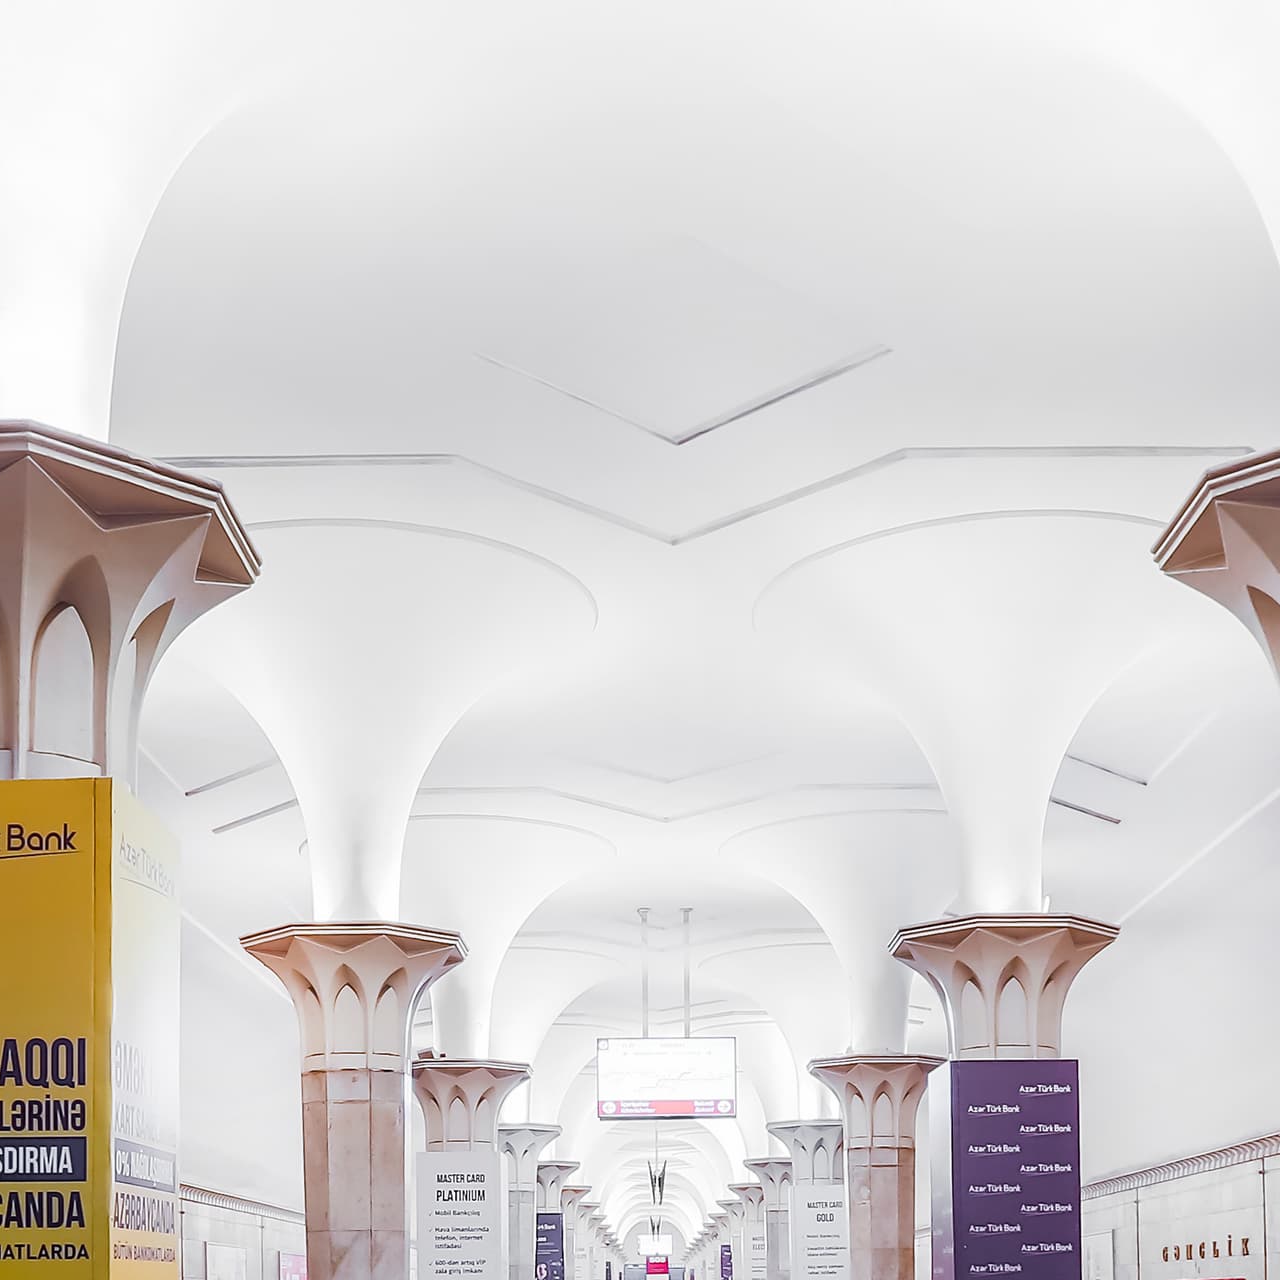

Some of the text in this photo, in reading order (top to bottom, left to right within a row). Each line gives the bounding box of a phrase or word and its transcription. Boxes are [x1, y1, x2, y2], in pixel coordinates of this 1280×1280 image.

[7, 823, 77, 851] Bank
[436, 1173, 486, 1183] MASTER CARD
[436, 1189, 486, 1201] PLATINIUM
[816, 1213, 834, 1222] GOLD
